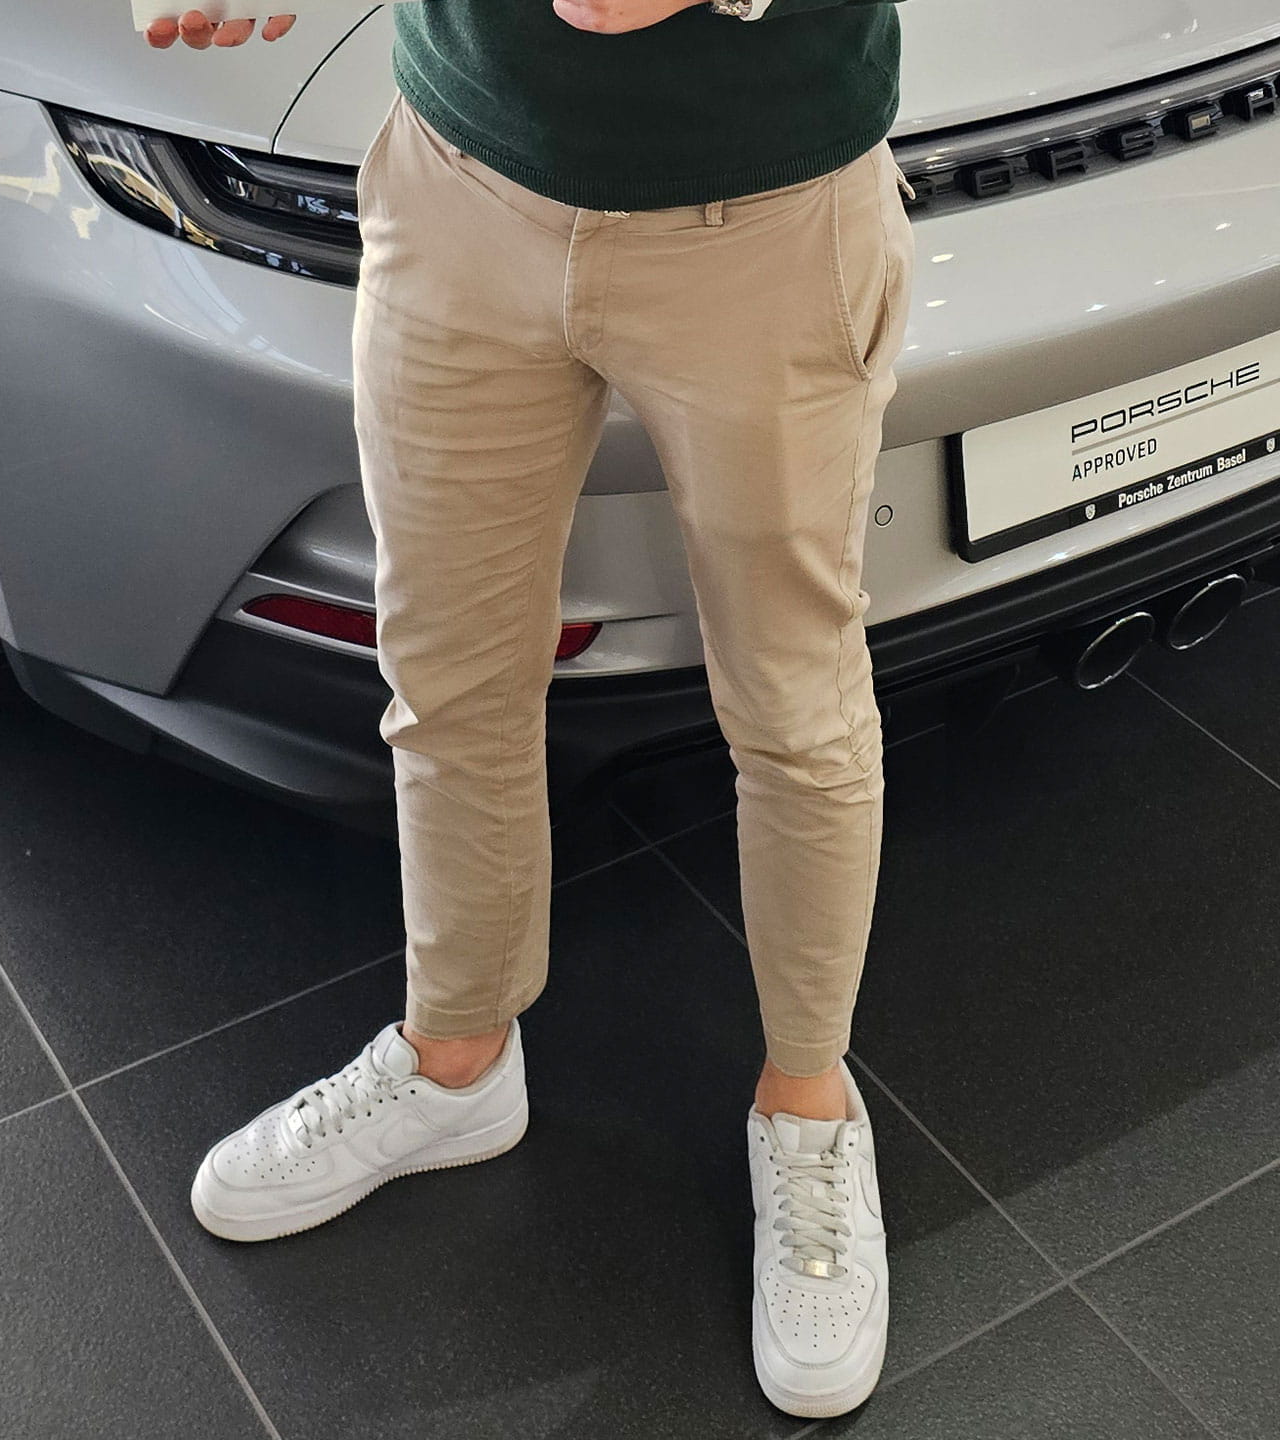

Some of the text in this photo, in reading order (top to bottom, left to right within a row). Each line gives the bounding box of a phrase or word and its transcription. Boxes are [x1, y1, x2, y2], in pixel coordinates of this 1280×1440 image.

[1071, 362, 1260, 444] PORSCHE
[1072, 437, 1158, 482] APPROVED
[1118, 447, 1247, 508] Porsche Zentrum Basel
